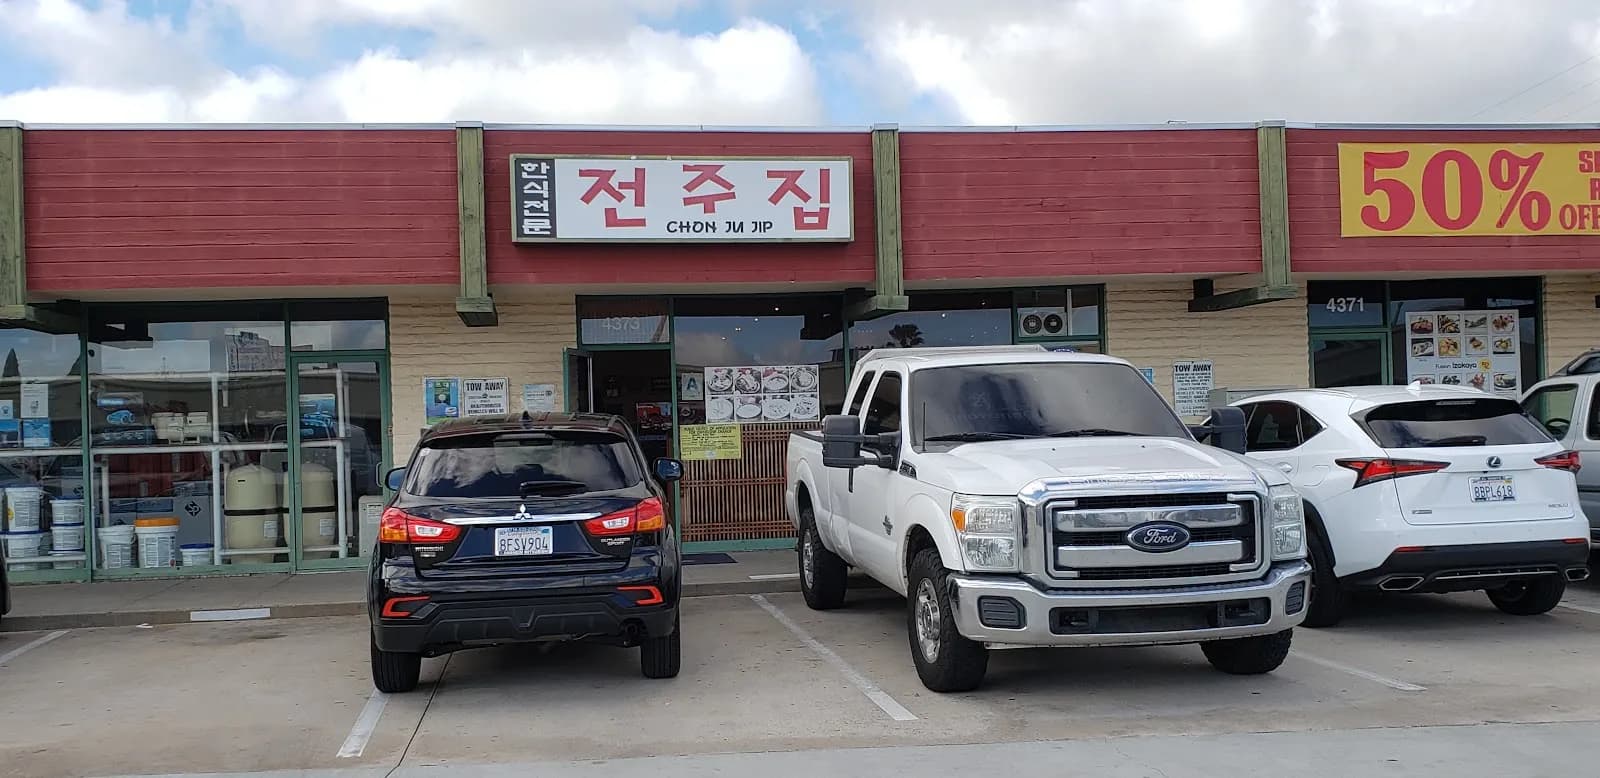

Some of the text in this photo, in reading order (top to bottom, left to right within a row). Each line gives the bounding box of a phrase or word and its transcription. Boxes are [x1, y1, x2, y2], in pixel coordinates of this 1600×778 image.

[578, 164, 830, 230] 전주집
[1361, 150, 1551, 231] 50%
[521, 162, 551, 234] 한식전문
[666, 221, 773, 233] CHON JU JIP
[1326, 297, 1365, 312] 4371
[1175, 364, 1212, 372] TOW AWAY
[466, 382, 482, 391] TOW
[485, 382, 504, 391] AWAY
[686, 377, 698, 390] A
[1474, 485, 1513, 498] 8BPL618
[1143, 528, 1177, 544] Ford
